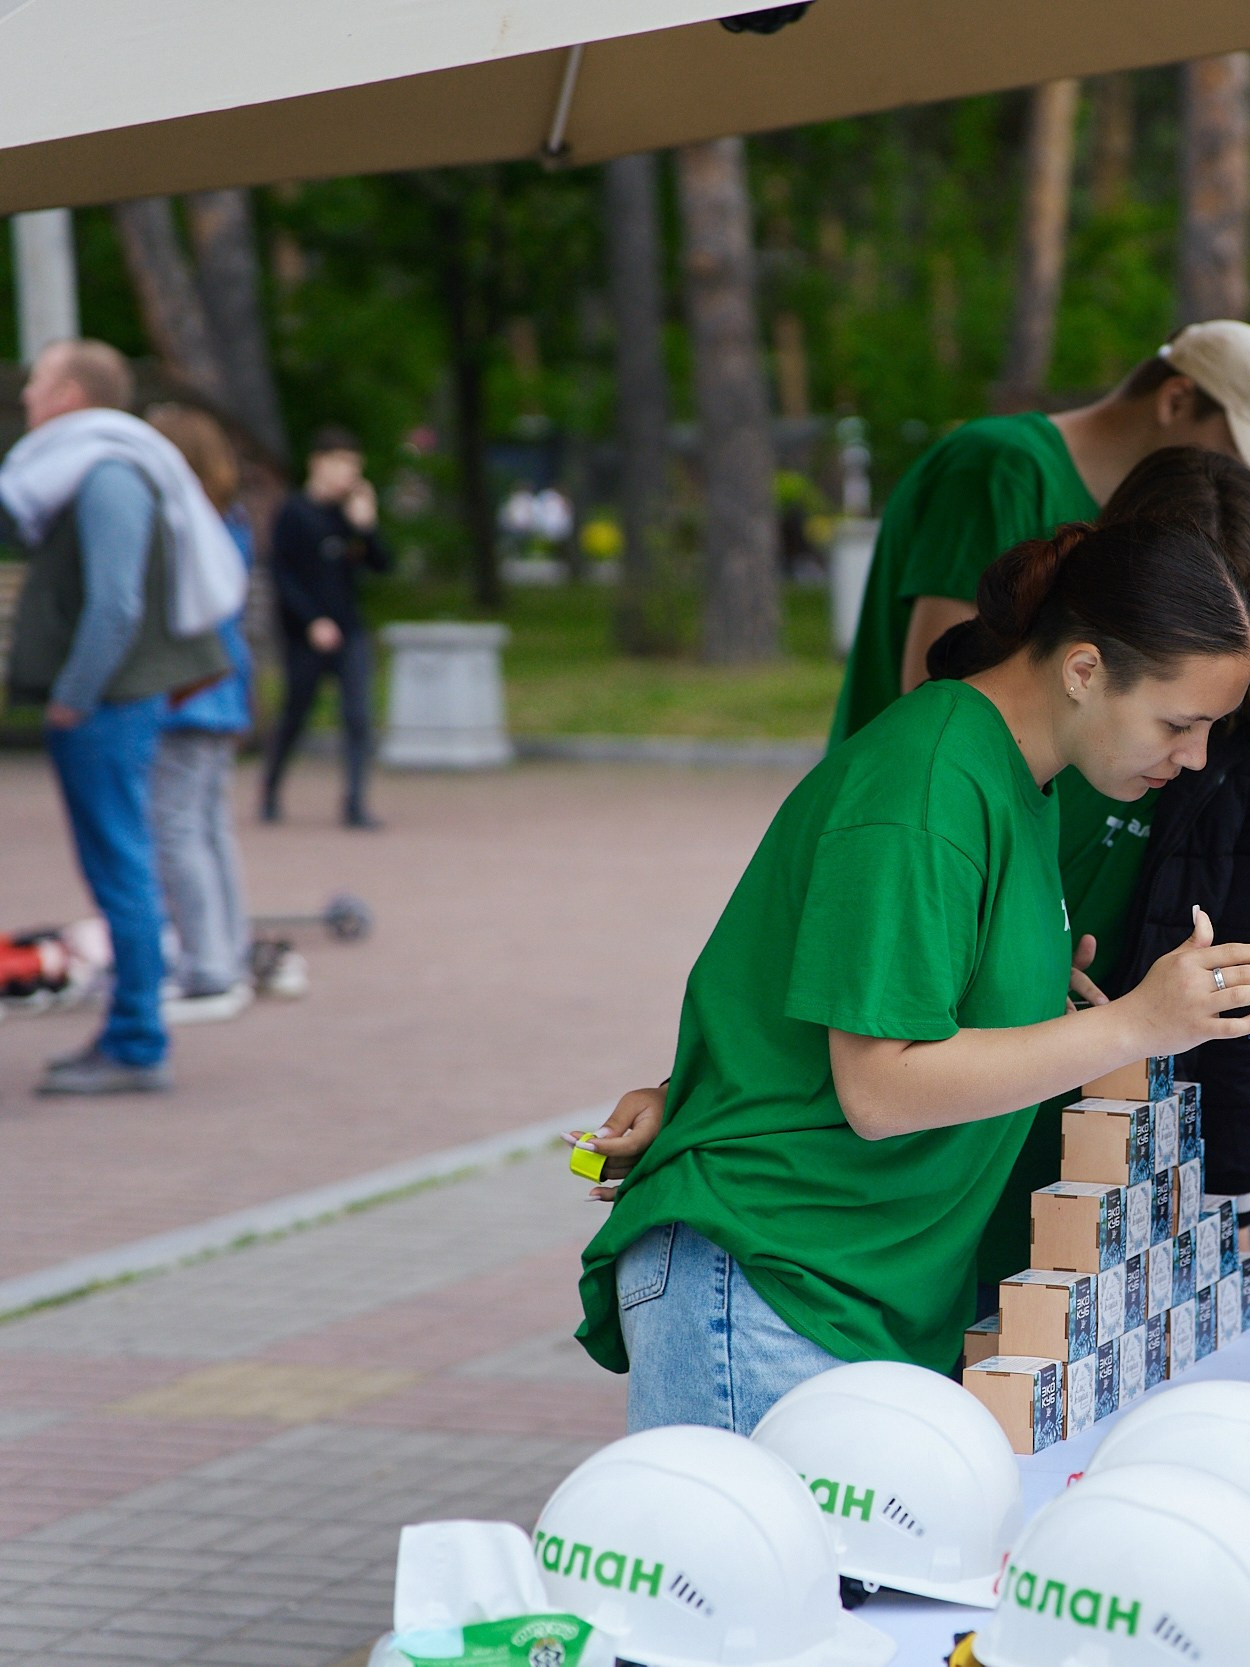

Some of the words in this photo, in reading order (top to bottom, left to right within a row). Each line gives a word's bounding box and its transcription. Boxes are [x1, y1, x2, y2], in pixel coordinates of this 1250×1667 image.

[1107, 1206, 1120, 1220] ЭКО
[1107, 1216, 1120, 1230] КУБ
[1076, 1295, 1090, 1310] ЭКО
[1076, 1306, 1090, 1320] КУБ
[1099, 1355, 1113, 1369] ЭКО
[1099, 1366, 1113, 1379] КУБ
[1041, 1382, 1056, 1397] ЭКО
[1041, 1393, 1056, 1408] КУБ
[798, 1473, 876, 1522] ан
